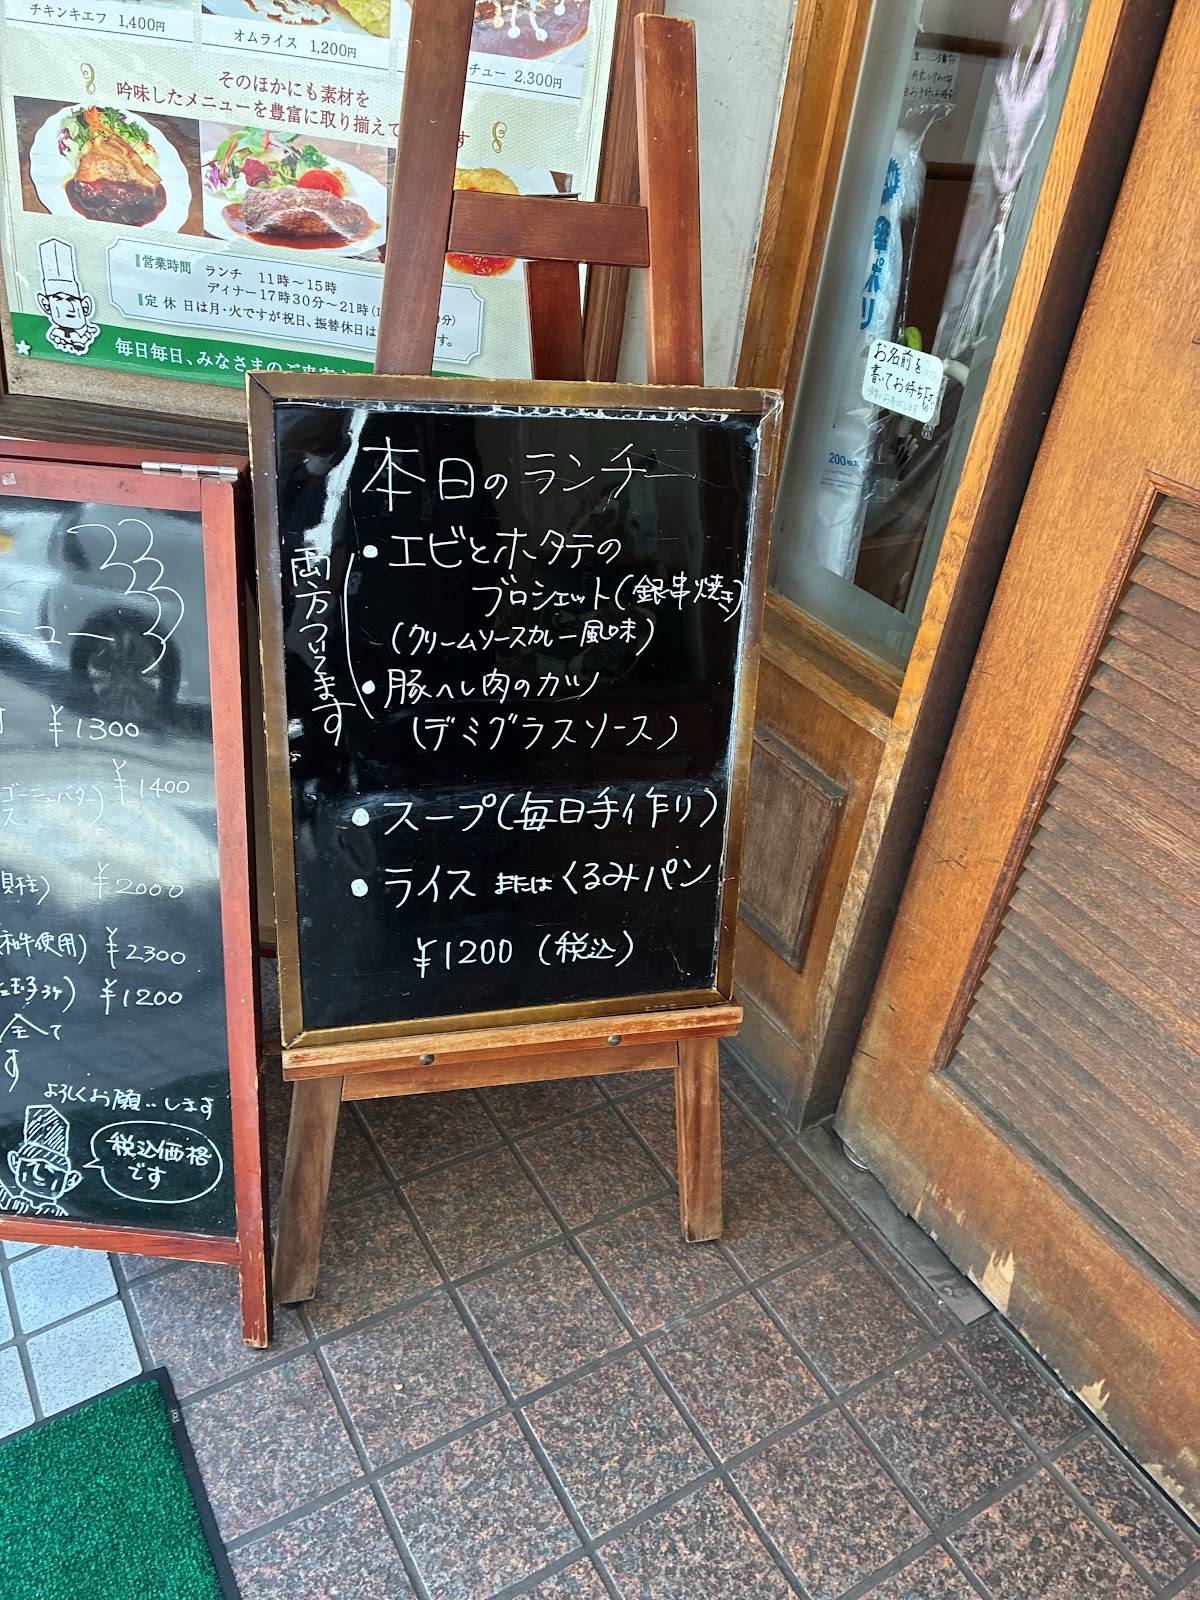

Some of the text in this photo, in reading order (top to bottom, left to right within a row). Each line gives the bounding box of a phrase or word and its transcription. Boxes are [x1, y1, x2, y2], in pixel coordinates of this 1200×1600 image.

[29, 3, 166, 33] チキンキエフ 1,400円
[233, 29, 357, 59] オムライス 1,200円
[218, 71, 370, 108] そのほかにも素材を
[514, 69, 563, 89] 2,300円
[142, 254, 192, 275] 営業時間
[205, 265, 242, 279] ランチ
[873, 342, 921, 375] お名前を
[388, 525, 623, 571] エビとホタテの
[290, 546, 357, 746] 両方ついてます
[48, 704, 140, 748] ¥1300
[112, 758, 191, 806] ¥1400
[93, 860, 184, 900] ¥2000
[384, 857, 713, 909] ライス または くるみパン
[105, 926, 187, 970] ¥2300
[412, 930, 635, 979] ¥1200 (税込)
[99, 977, 184, 1016] ¥1200
[105, 1131, 213, 1167] 税込価格
[127, 1162, 168, 1191] です
